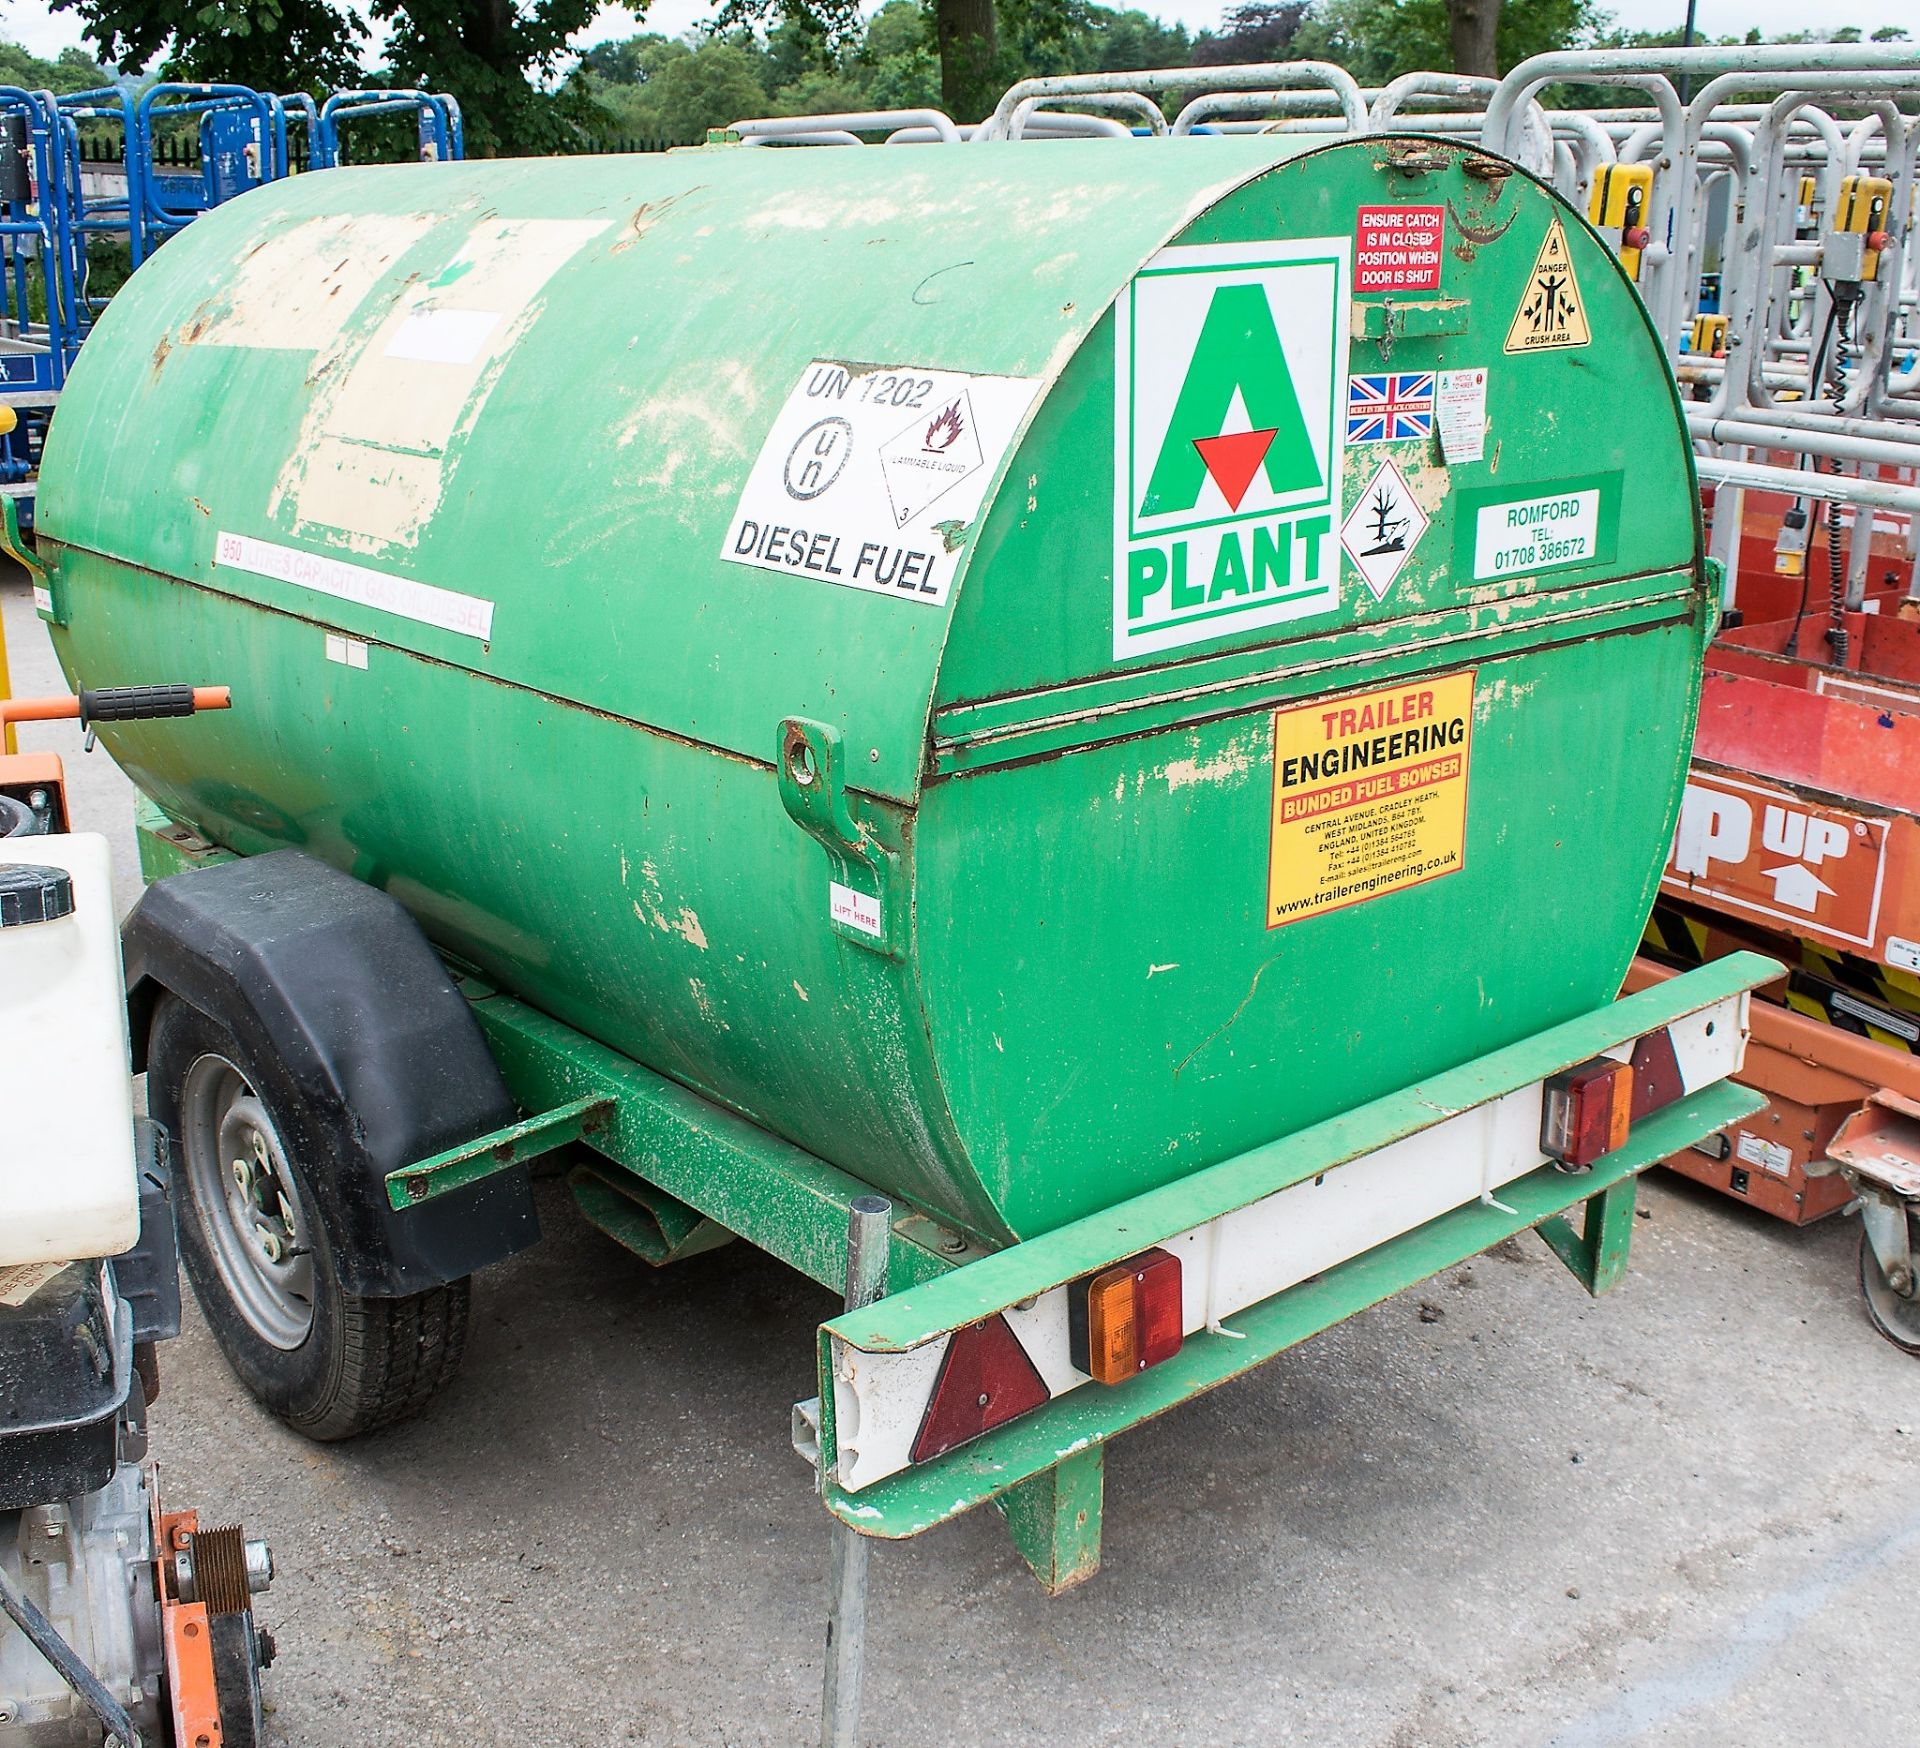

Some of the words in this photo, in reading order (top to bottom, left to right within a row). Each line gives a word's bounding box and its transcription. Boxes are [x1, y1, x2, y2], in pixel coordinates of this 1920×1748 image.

[1362, 214, 1403, 228] ENSURE
[1406, 214, 1439, 227] CATCH
[1367, 233, 1377, 247] IS
[1379, 233, 1390, 246] IN
[1392, 232, 1433, 246] CLOSED
[1358, 252, 1407, 266] POSITION
[1409, 251, 1438, 265] WHEN
[1539, 263, 1568, 274] DANGER
[1362, 271, 1392, 285] DOOR
[1394, 271, 1404, 284] IS
[1406, 270, 1433, 283] SHUT
[1525, 335, 1550, 346] CRUSH
[1552, 333, 1571, 343] AREA
[807, 368, 852, 400] UN
[860, 374, 934, 409] 1202
[1138, 283, 1324, 518] A
[938, 463, 966, 474] LIQUID
[899, 507, 909, 521] 3
[1507, 499, 1580, 527] ROMFORD
[1531, 528, 1554, 542] TEL:
[734, 520, 842, 575] DIESEL
[853, 542, 938, 595] FUEL
[1495, 546, 1535, 569] 01708
[1540, 537, 1585, 562] 386672
[222, 538, 242, 562] 950
[293, 557, 363, 593] CAPACITY
[1128, 514, 1331, 620] PLANT
[1322, 691, 1434, 740] TRAILER
[1282, 717, 1464, 788] ENGINEERING
[1284, 787, 1353, 820] BUNDED
[1356, 776, 1395, 802] FUEL
[1399, 758, 1460, 790] BOWSER
[1304, 818, 1341, 834] CENTRAL
[1380, 798, 1412, 814] CRADLEY
[1324, 827, 1346, 840] WEST
[1360, 826, 1389, 841] UNITED
[1762, 804, 1850, 865] UP
[1330, 851, 1344, 860] Tel:
[1328, 862, 1344, 872] Fax:
[1276, 850, 1457, 916] www.trailerengineering.co.uk
[1320, 872, 1346, 885] E-mail:
[834, 903, 851, 917] LIFT
[854, 911, 877, 928] HERE
